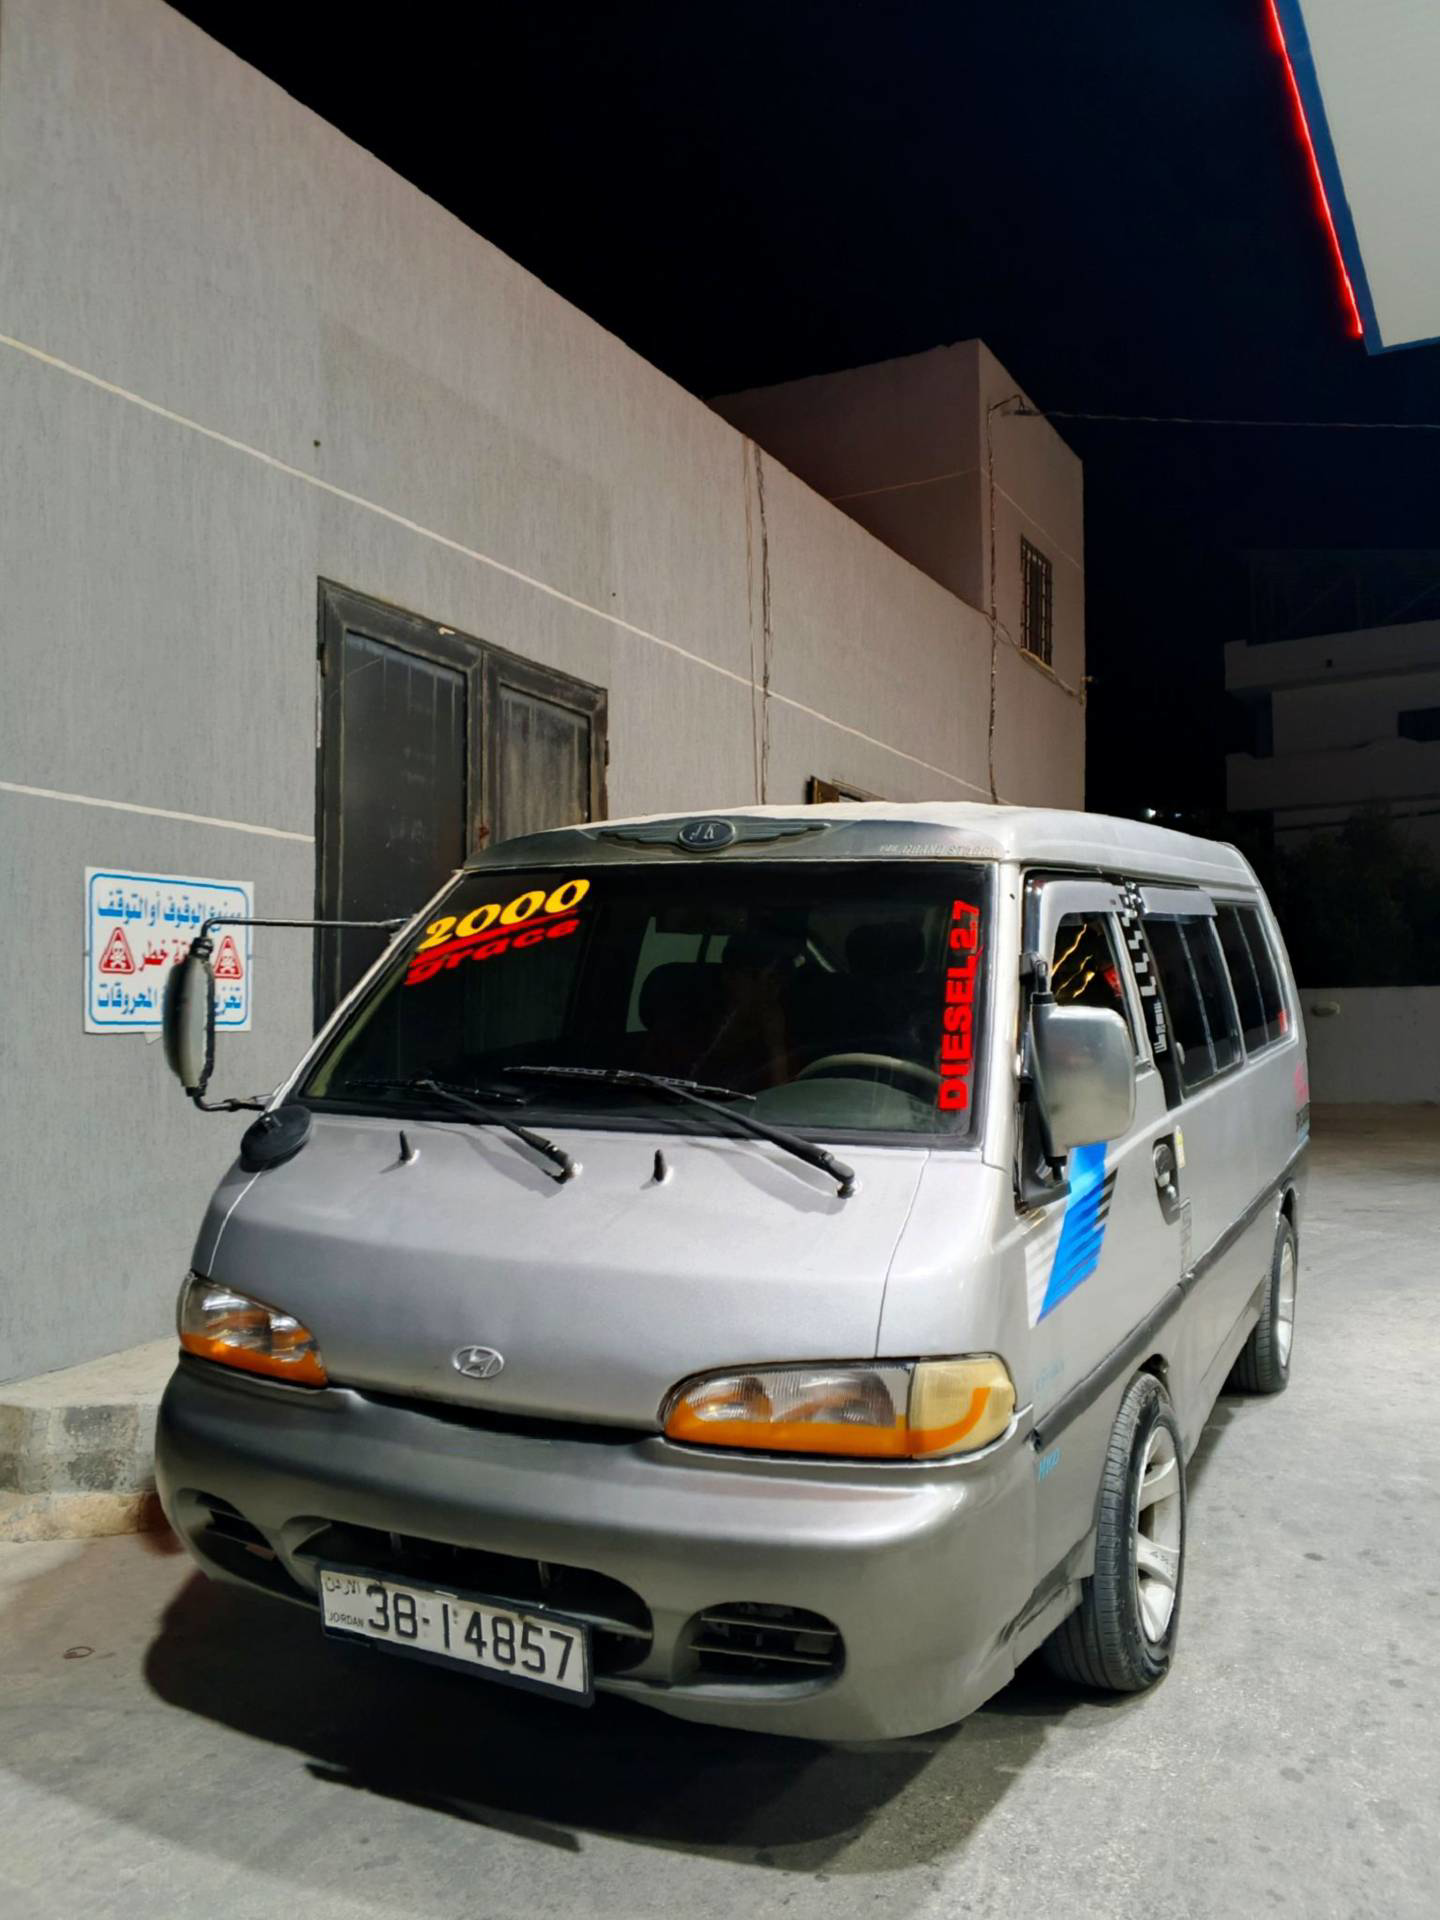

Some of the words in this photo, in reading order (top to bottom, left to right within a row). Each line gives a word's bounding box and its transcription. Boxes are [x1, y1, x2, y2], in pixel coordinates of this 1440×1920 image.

[97, 889, 149, 924] التوقف
[163, 895, 206, 930] الوقوف
[416, 879, 591, 951] 2000
[139, 939, 169, 972] خطر
[97, 981, 158, 1015] المحروقات
[937, 953, 980, 1112] DIESEL
[328, 1611, 365, 1628] JORDAN
